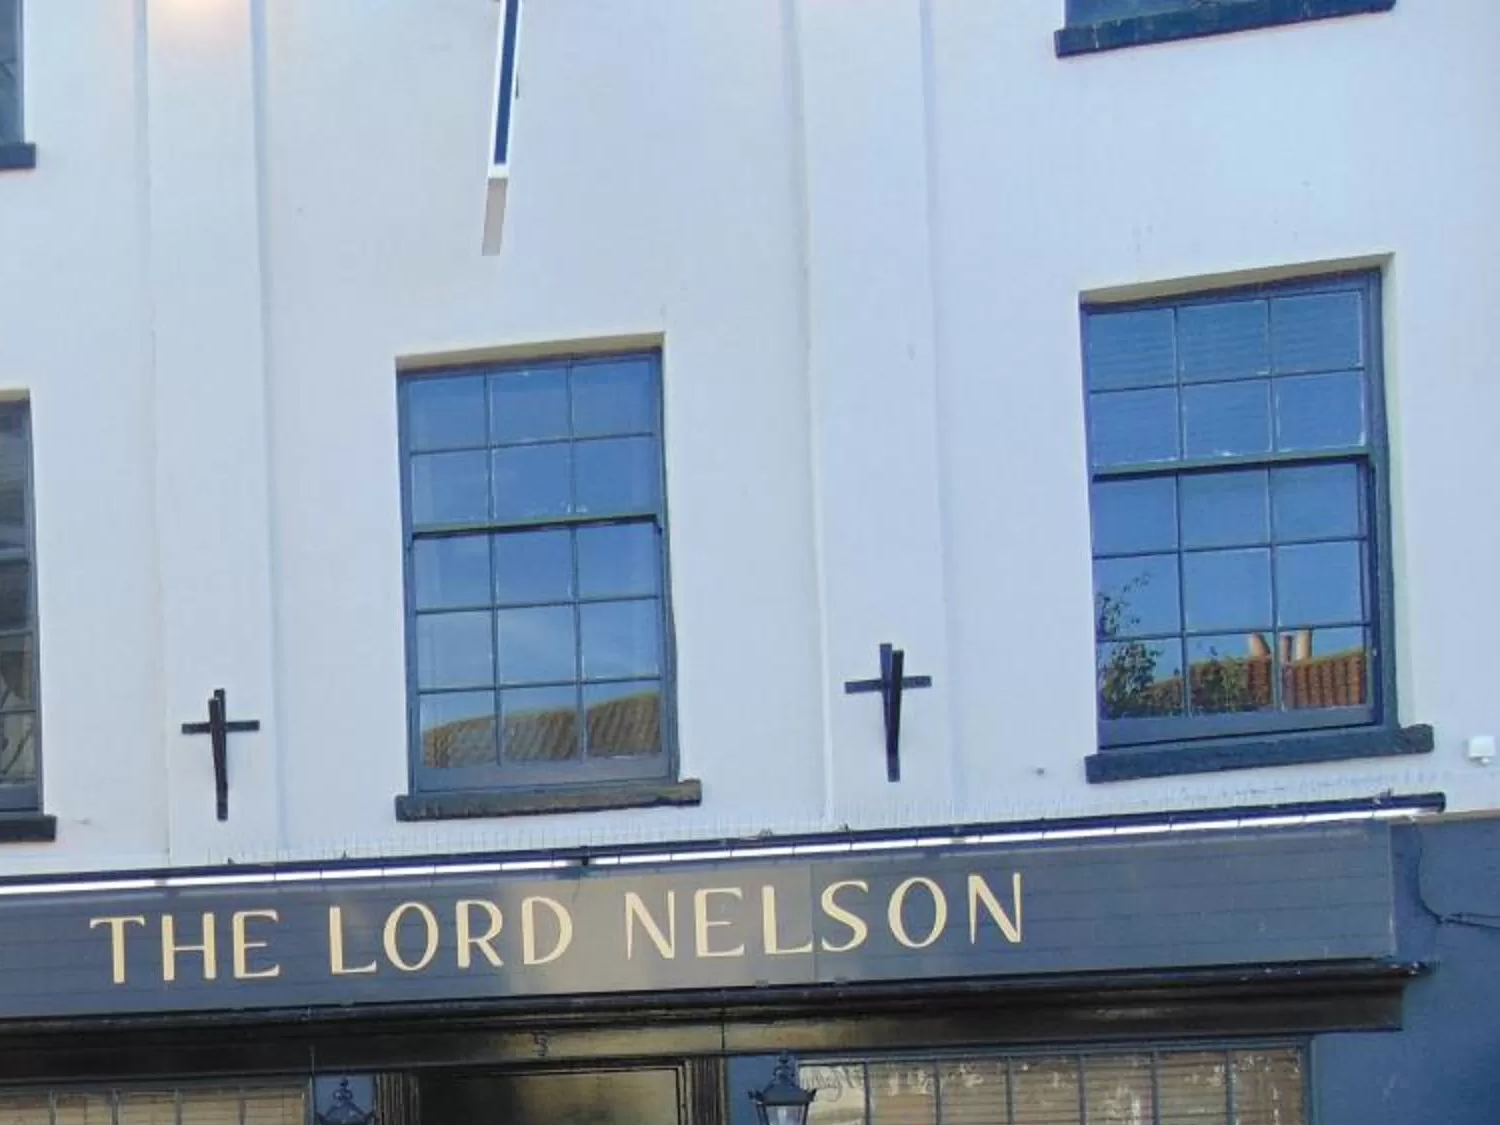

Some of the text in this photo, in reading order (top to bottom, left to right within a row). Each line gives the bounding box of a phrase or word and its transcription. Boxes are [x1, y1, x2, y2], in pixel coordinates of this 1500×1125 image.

[90, 872, 1022, 984] THE LORD NELSON
